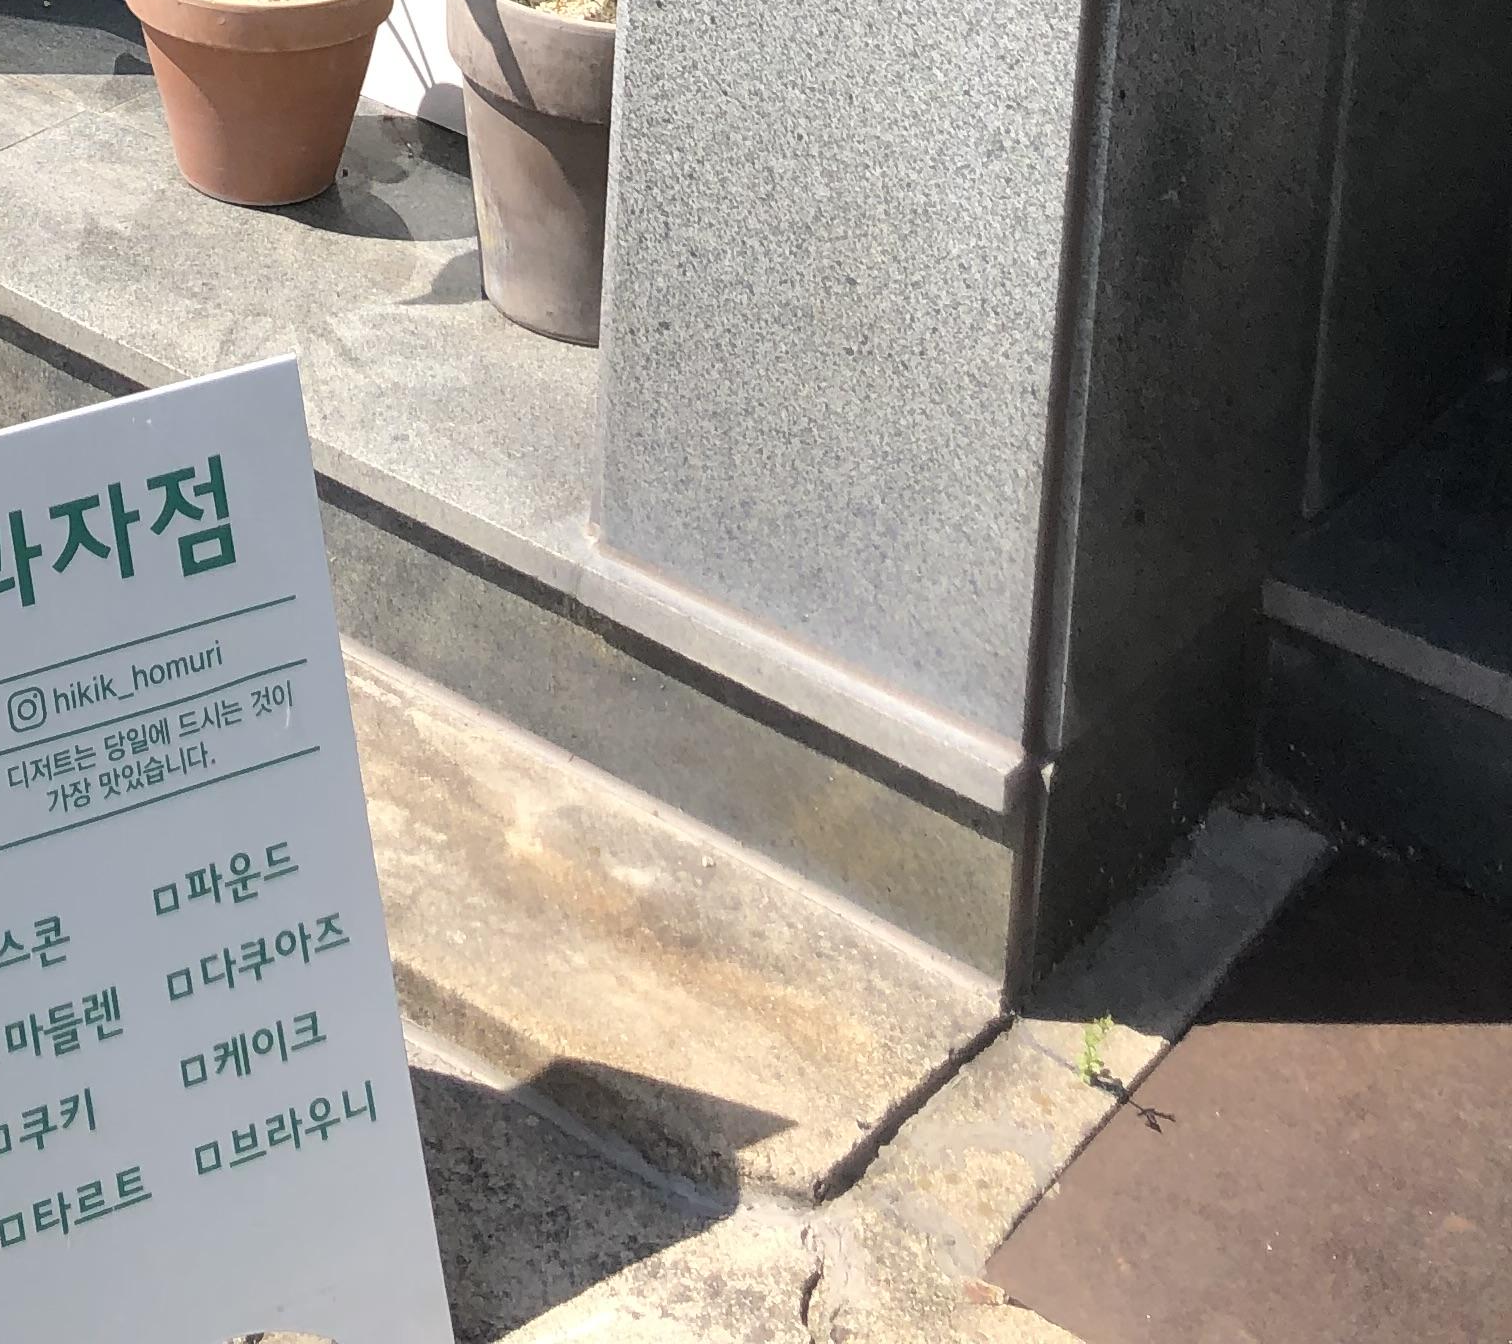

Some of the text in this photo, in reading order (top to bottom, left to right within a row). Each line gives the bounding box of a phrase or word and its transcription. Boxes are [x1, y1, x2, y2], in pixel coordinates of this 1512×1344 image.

[52, 640, 224, 715] hikik_homuri
[7, 745, 97, 794] 디저트는
[102, 718, 172, 762] 당일에
[177, 699, 243, 738] 드시는
[250, 679, 295, 719] 것이
[46, 742, 217, 814] 가장 맛있습니다.
[185, 841, 299, 904] 파운드
[200, 912, 350, 988] 다쿠아즈
[5, 986, 124, 1057] 마들렌
[213, 1010, 327, 1077] 케이크
[19, 1088, 97, 1150] 쿠키
[229, 1080, 377, 1168] 브라우니
[33, 1166, 152, 1234] 타르트
